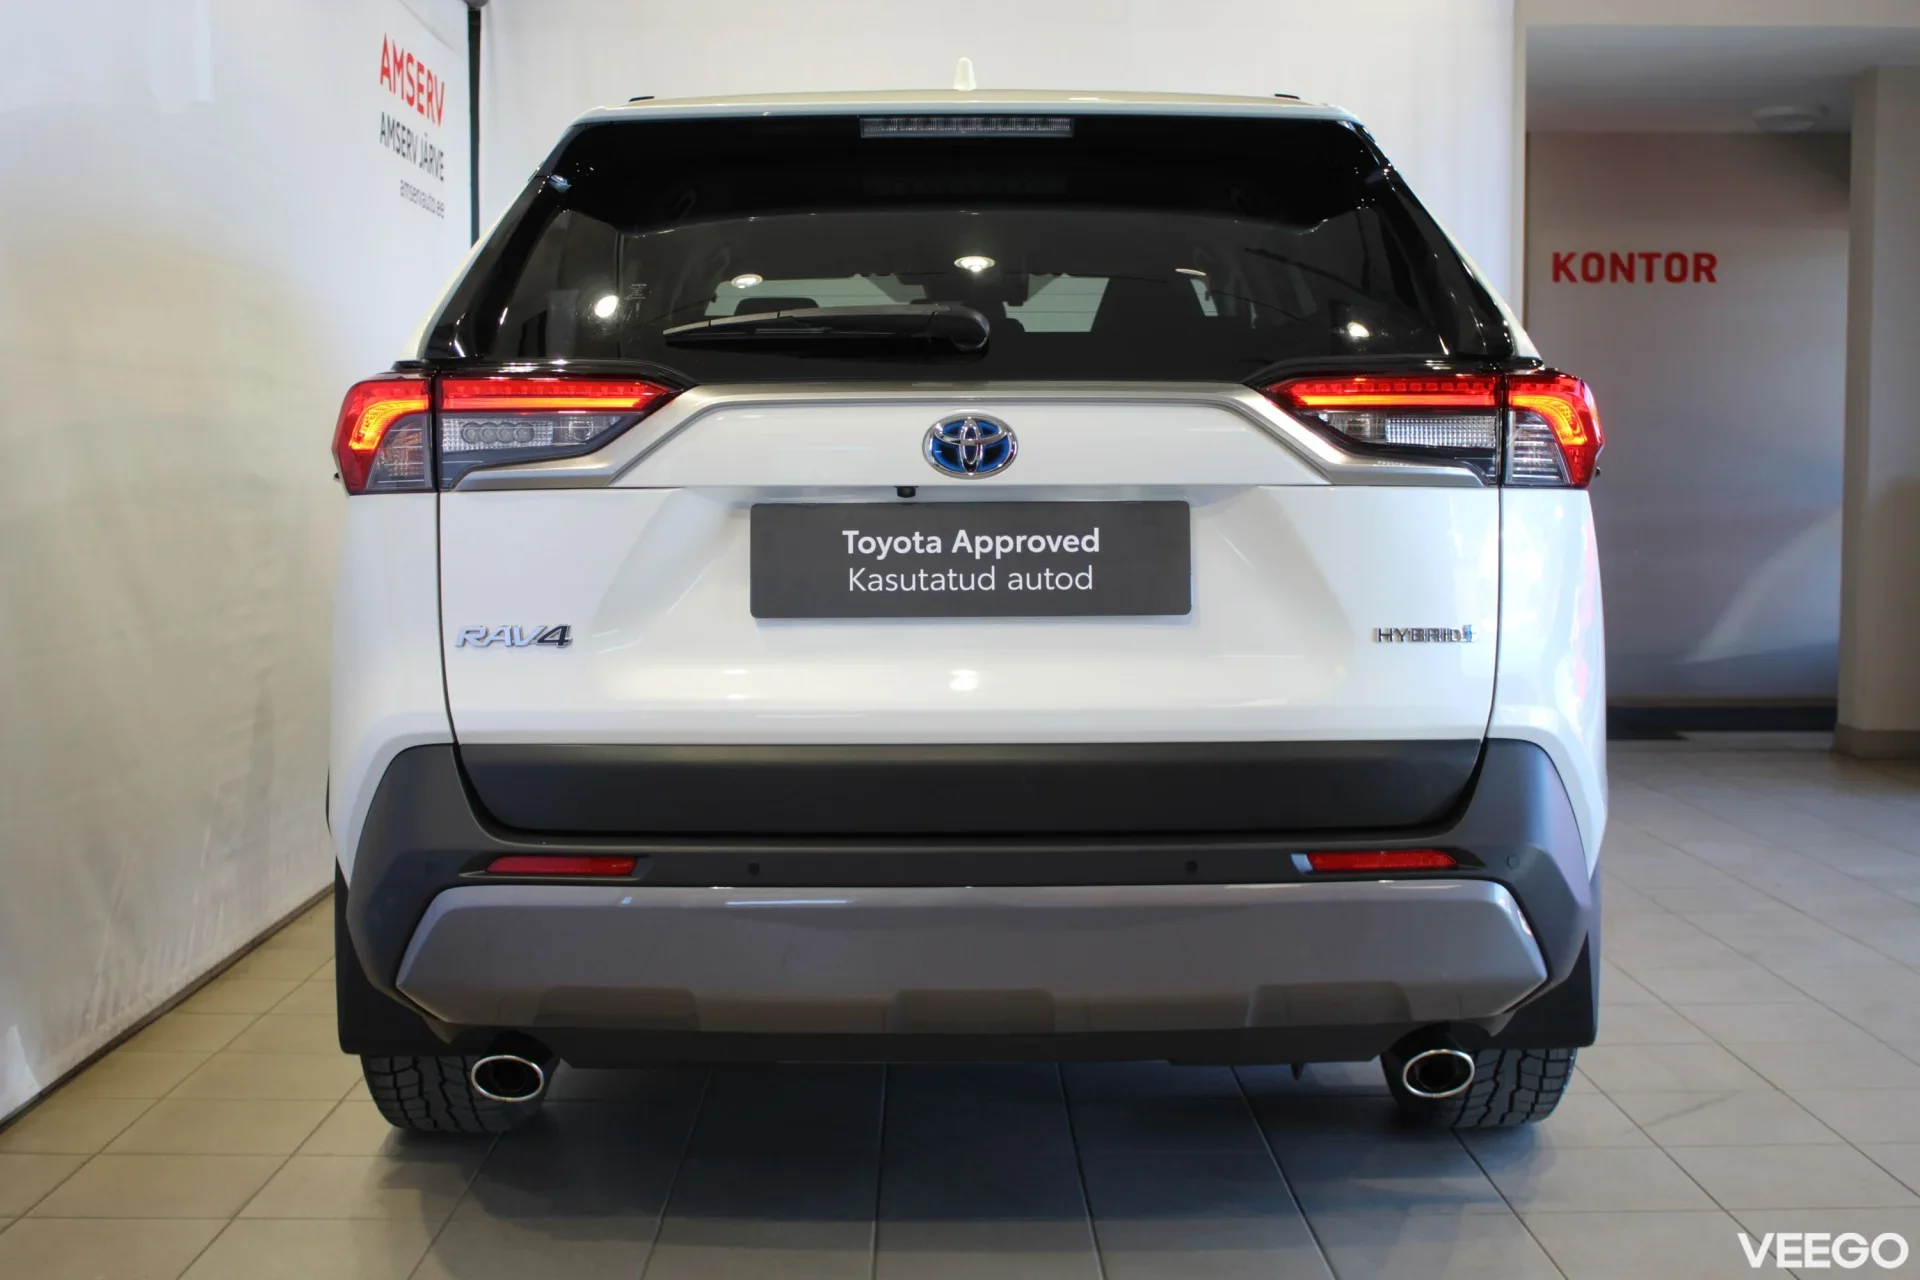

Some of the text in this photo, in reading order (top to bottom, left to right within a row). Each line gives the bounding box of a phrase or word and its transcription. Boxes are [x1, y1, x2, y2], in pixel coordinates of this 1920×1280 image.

[380, 32, 446, 127] AMSERV
[379, 111, 418, 165] AMSERV
[1552, 252, 1718, 284] KONTOR
[842, 527, 1100, 561] Toyota Approved
[849, 565, 1093, 592] Kasutatud autod
[456, 624, 572, 648] RAV4
